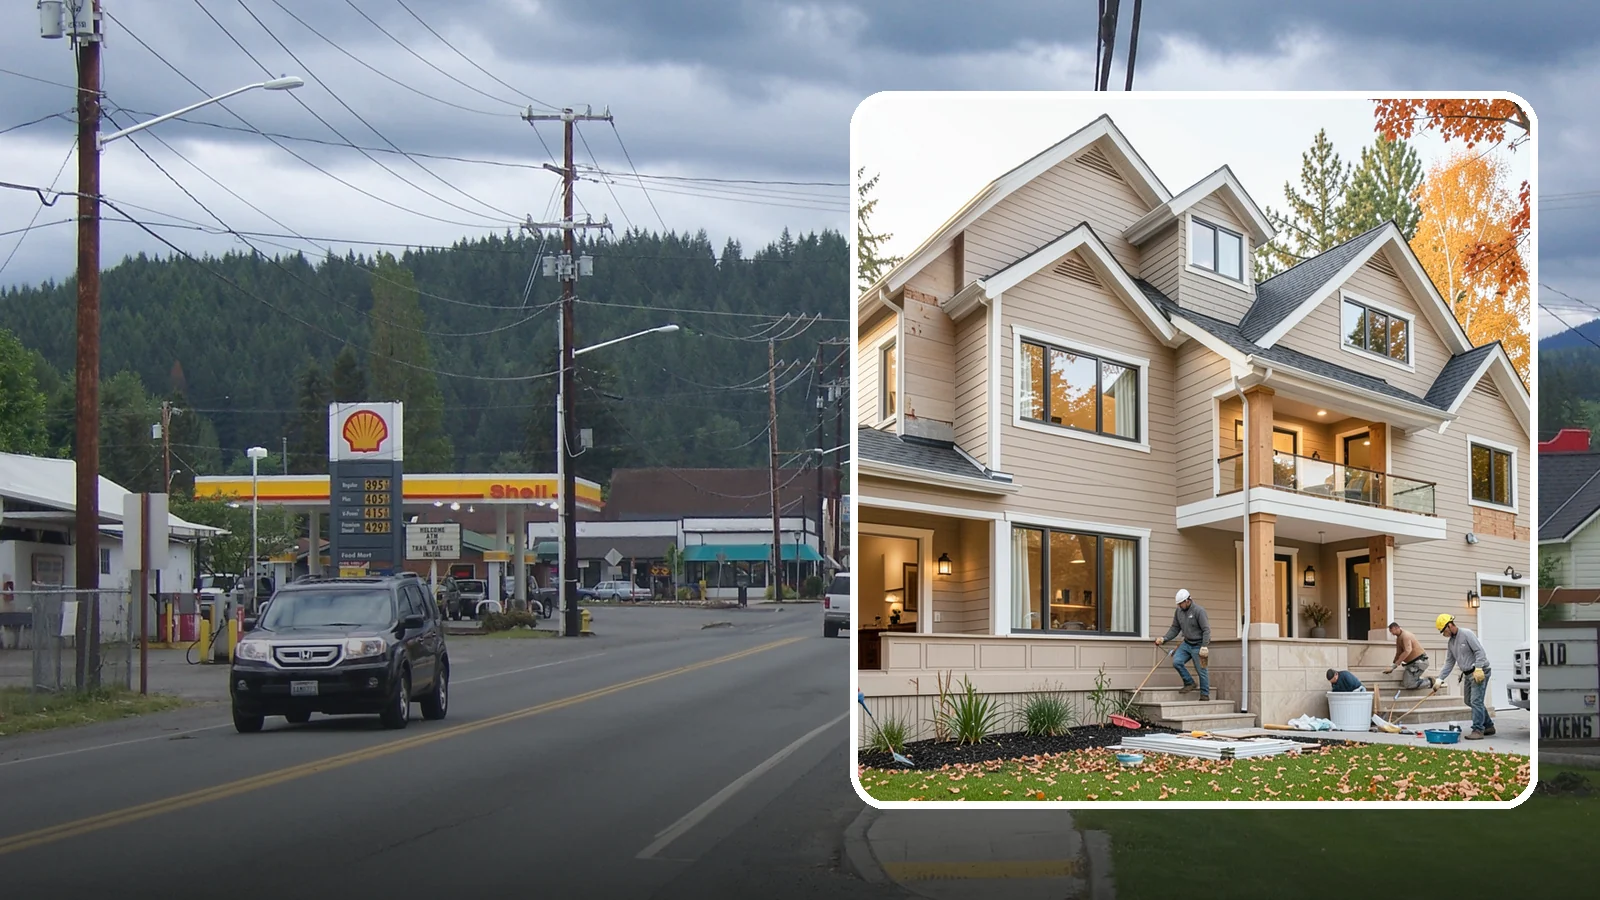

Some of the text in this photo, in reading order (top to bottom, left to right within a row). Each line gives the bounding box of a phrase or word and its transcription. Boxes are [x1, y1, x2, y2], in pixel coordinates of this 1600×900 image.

[366, 480, 383, 490] 395
[490, 484, 548, 499] Shell
[366, 494, 383, 504] 405
[366, 508, 383, 518] 415
[366, 522, 383, 532] 429
